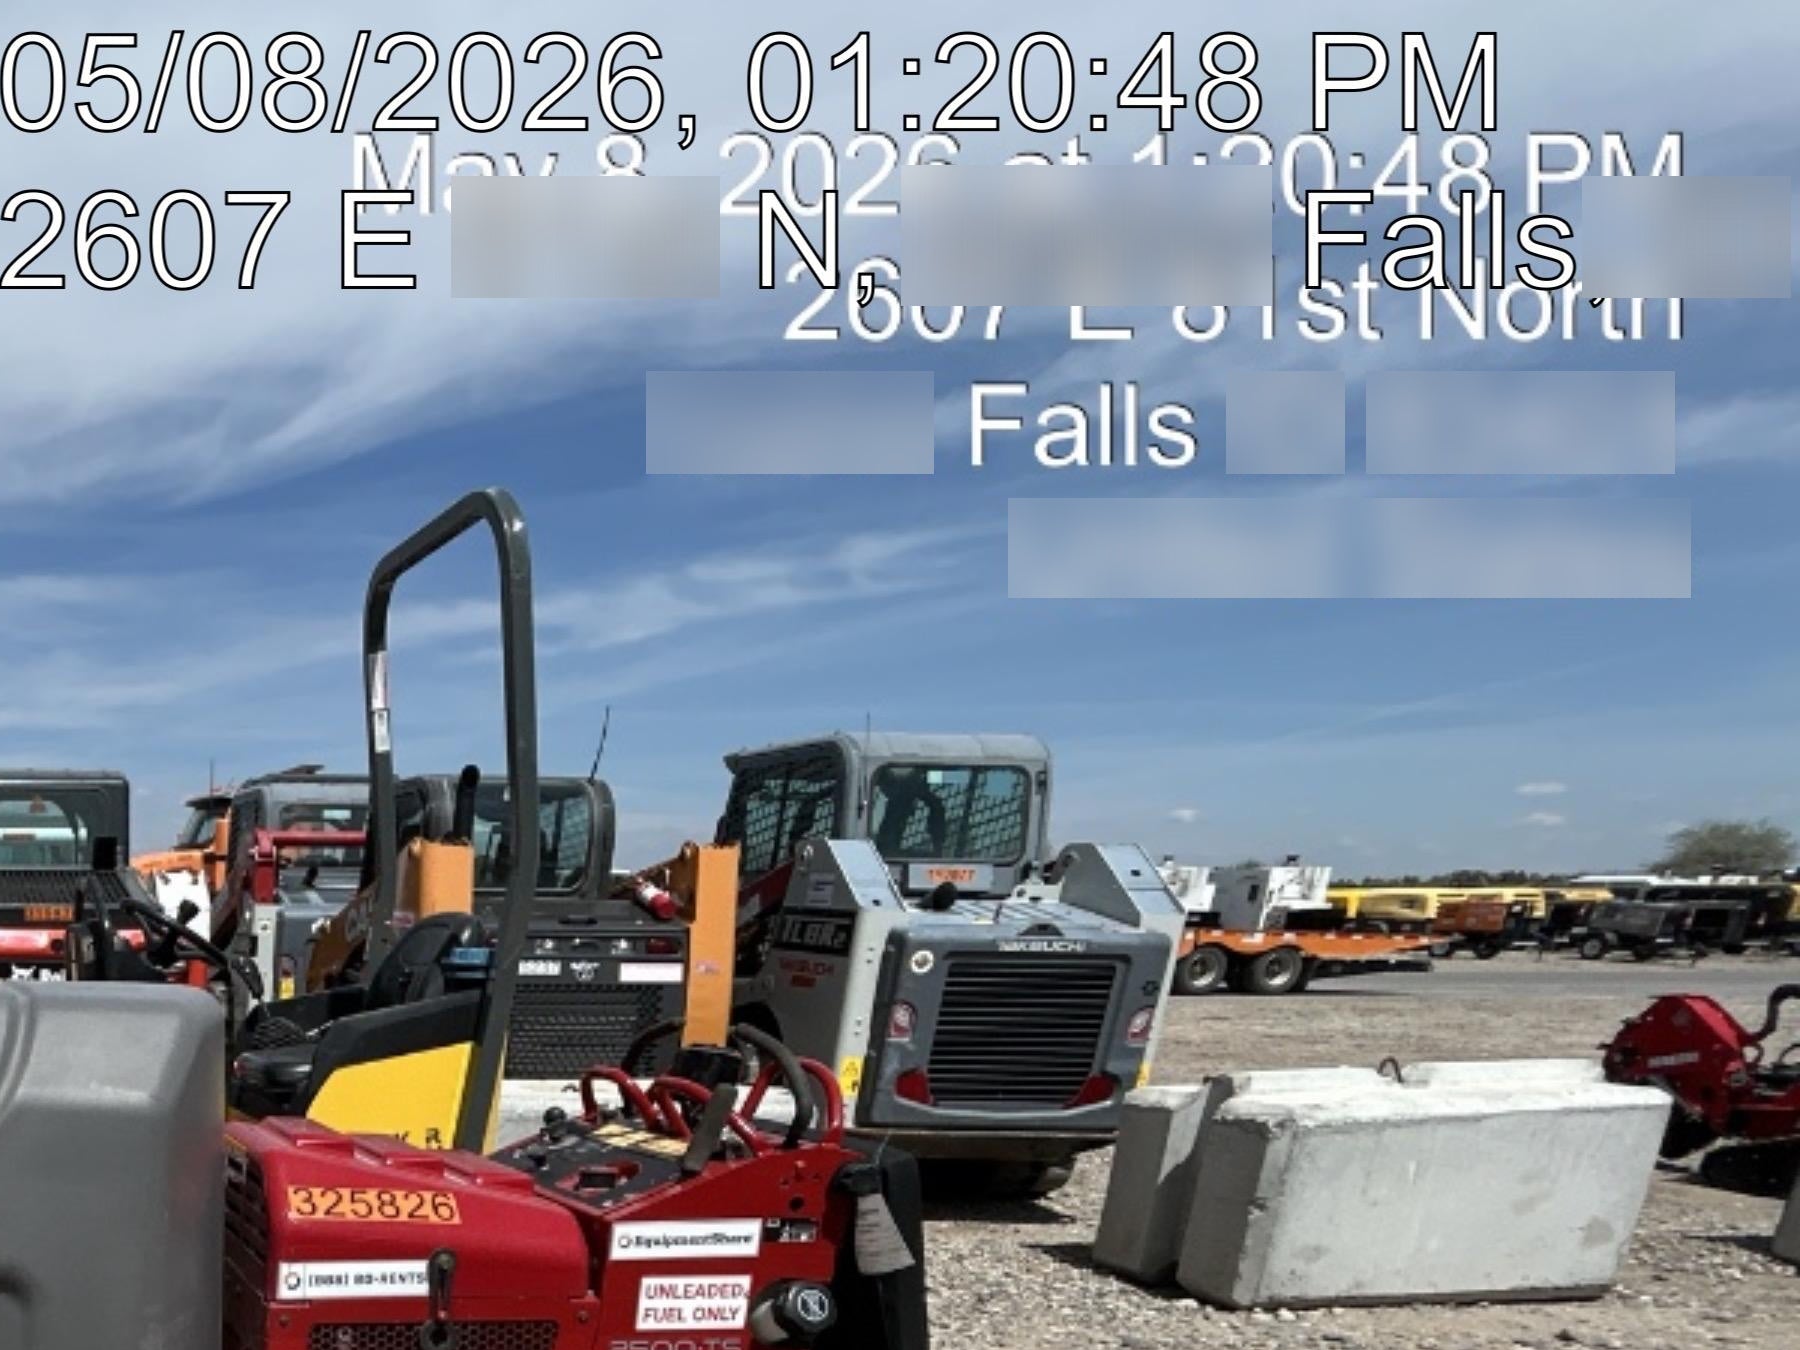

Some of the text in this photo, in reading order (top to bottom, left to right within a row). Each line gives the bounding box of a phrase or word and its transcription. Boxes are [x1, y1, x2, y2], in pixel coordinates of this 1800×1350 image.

[293, 1187, 455, 1222] 325826
[644, 1283, 744, 1300] UNLEADED
[641, 1305, 741, 1323] FUEL ONLY
